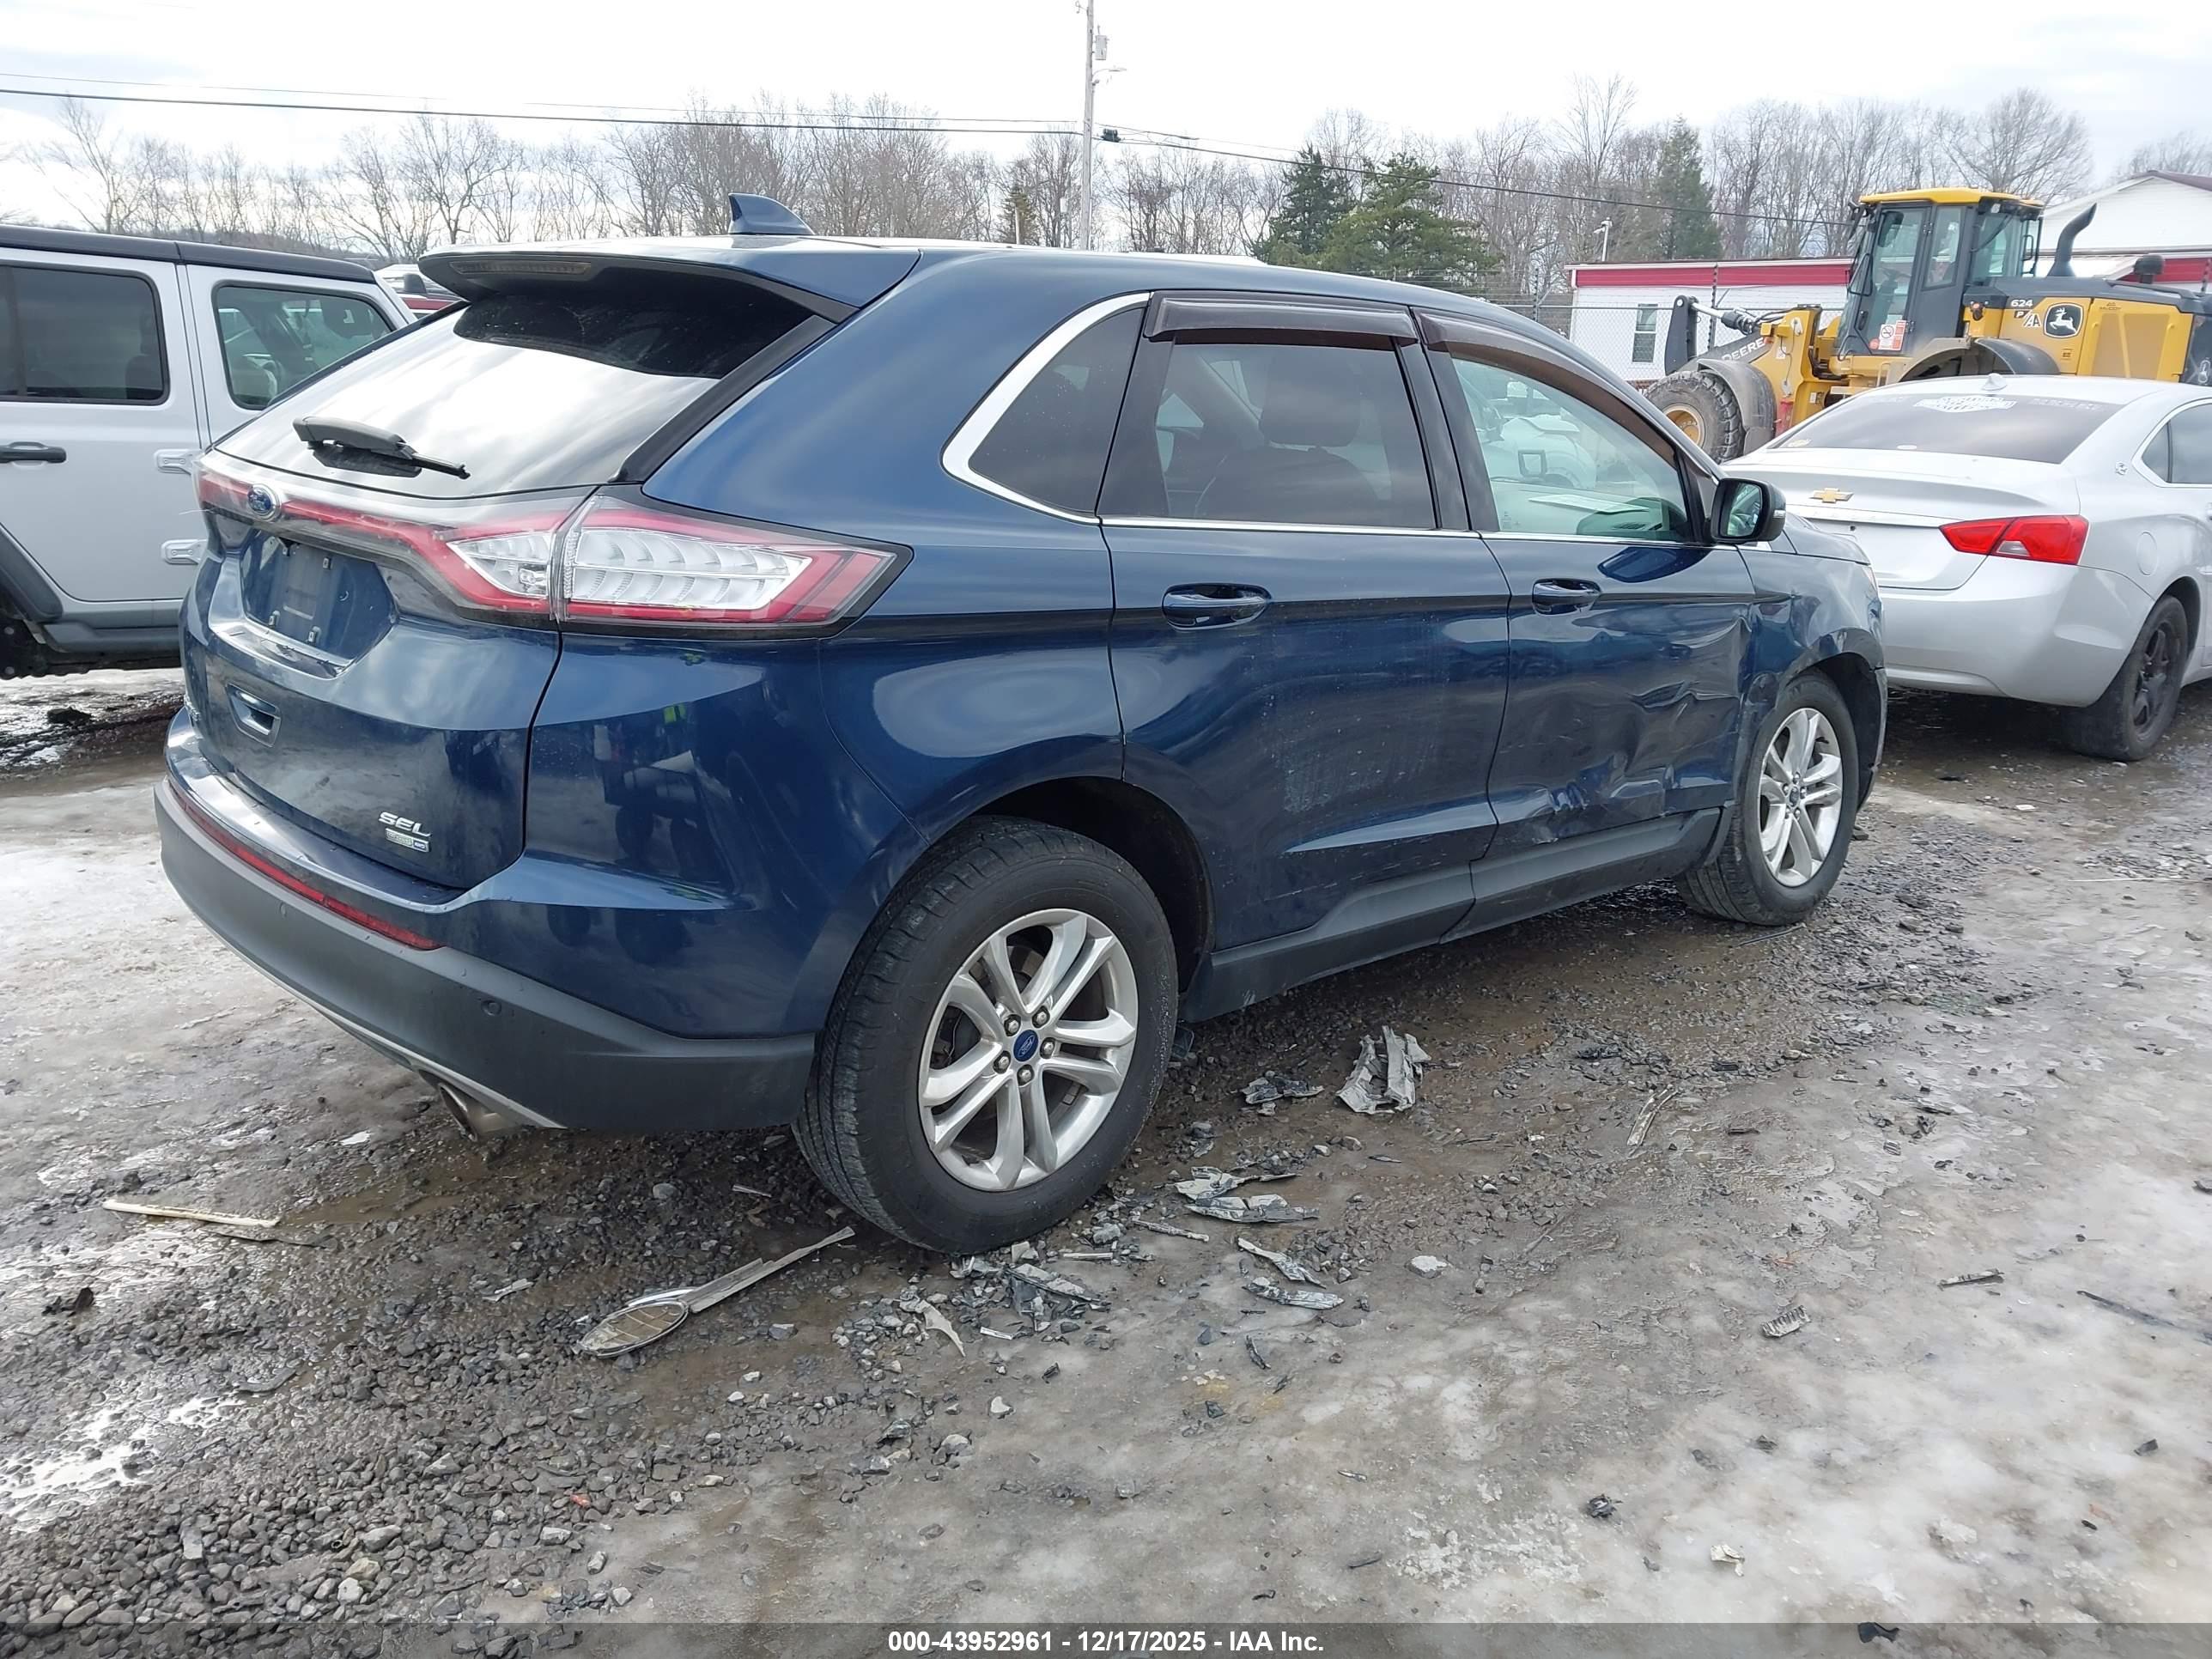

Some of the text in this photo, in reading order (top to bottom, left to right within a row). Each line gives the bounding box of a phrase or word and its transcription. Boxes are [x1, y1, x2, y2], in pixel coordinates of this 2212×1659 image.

[2010, 299, 2033, 307] 624
[1721, 337, 1766, 361] DEERE
[378, 811, 431, 837] SEL
